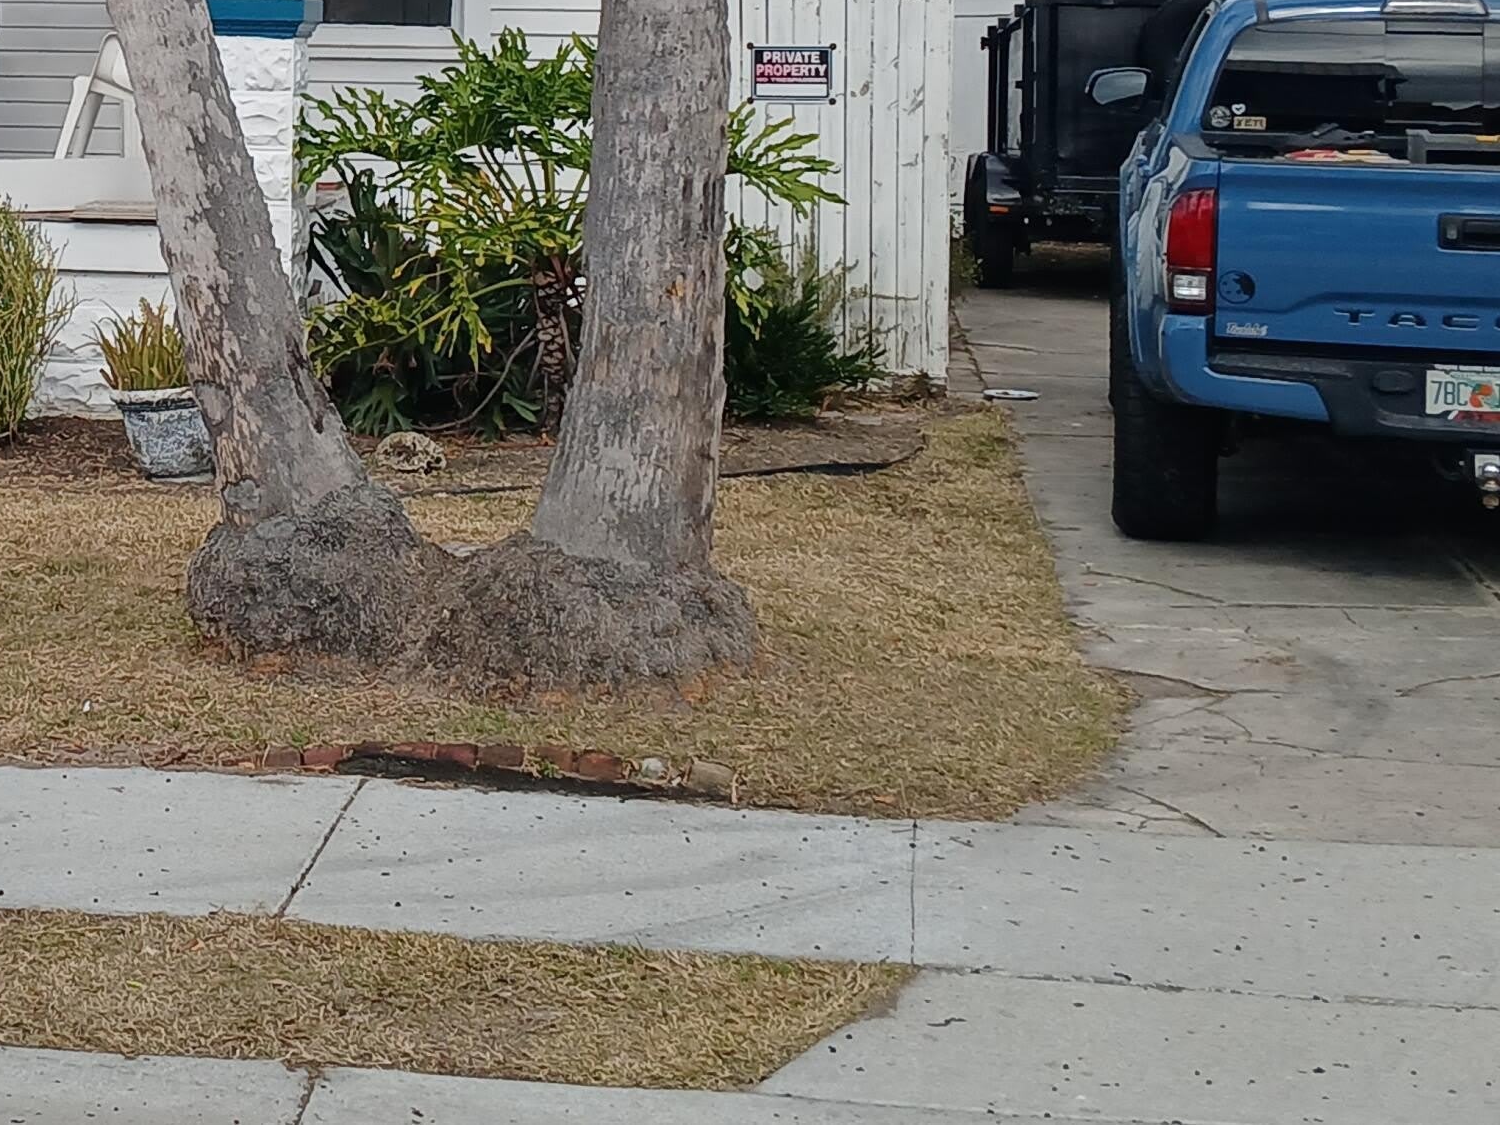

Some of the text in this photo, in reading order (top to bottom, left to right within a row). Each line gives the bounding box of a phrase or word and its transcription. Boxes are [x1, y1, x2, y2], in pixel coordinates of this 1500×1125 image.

[762, 51, 820, 63] PRIVATE
[755, 64, 827, 77] PROPERTY
[1332, 307, 1500, 332] TAC
